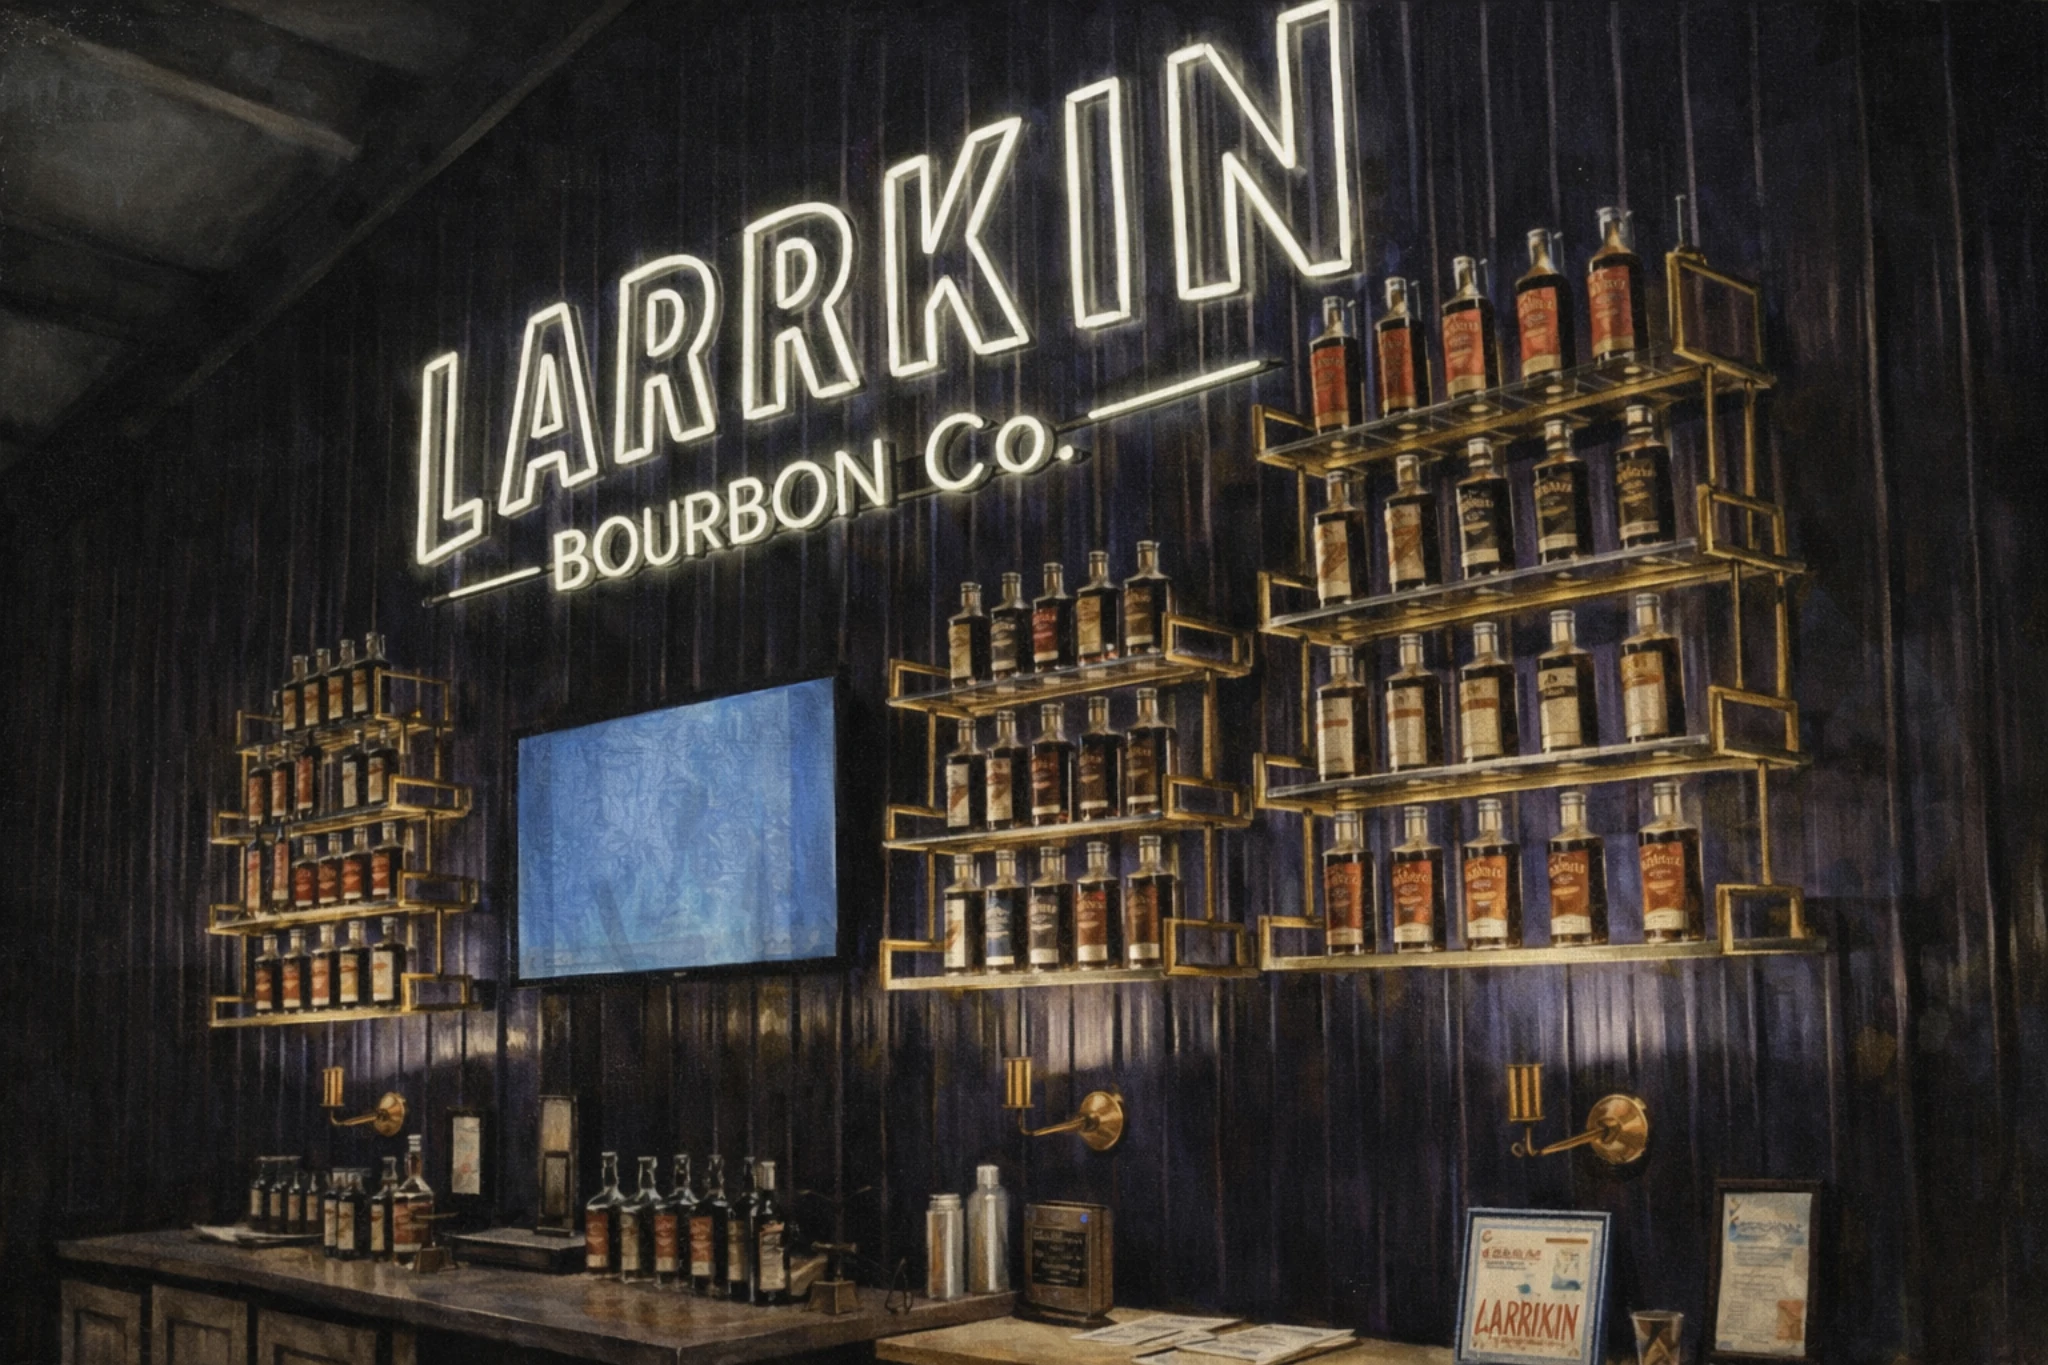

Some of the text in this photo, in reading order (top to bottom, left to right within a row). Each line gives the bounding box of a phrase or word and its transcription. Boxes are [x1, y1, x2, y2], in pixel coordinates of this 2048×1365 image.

[416, 0, 1354, 567] LARRKIN
[552, 437, 887, 592] BOURBON
[1474, 1298, 1580, 1340] LARRIKIN
